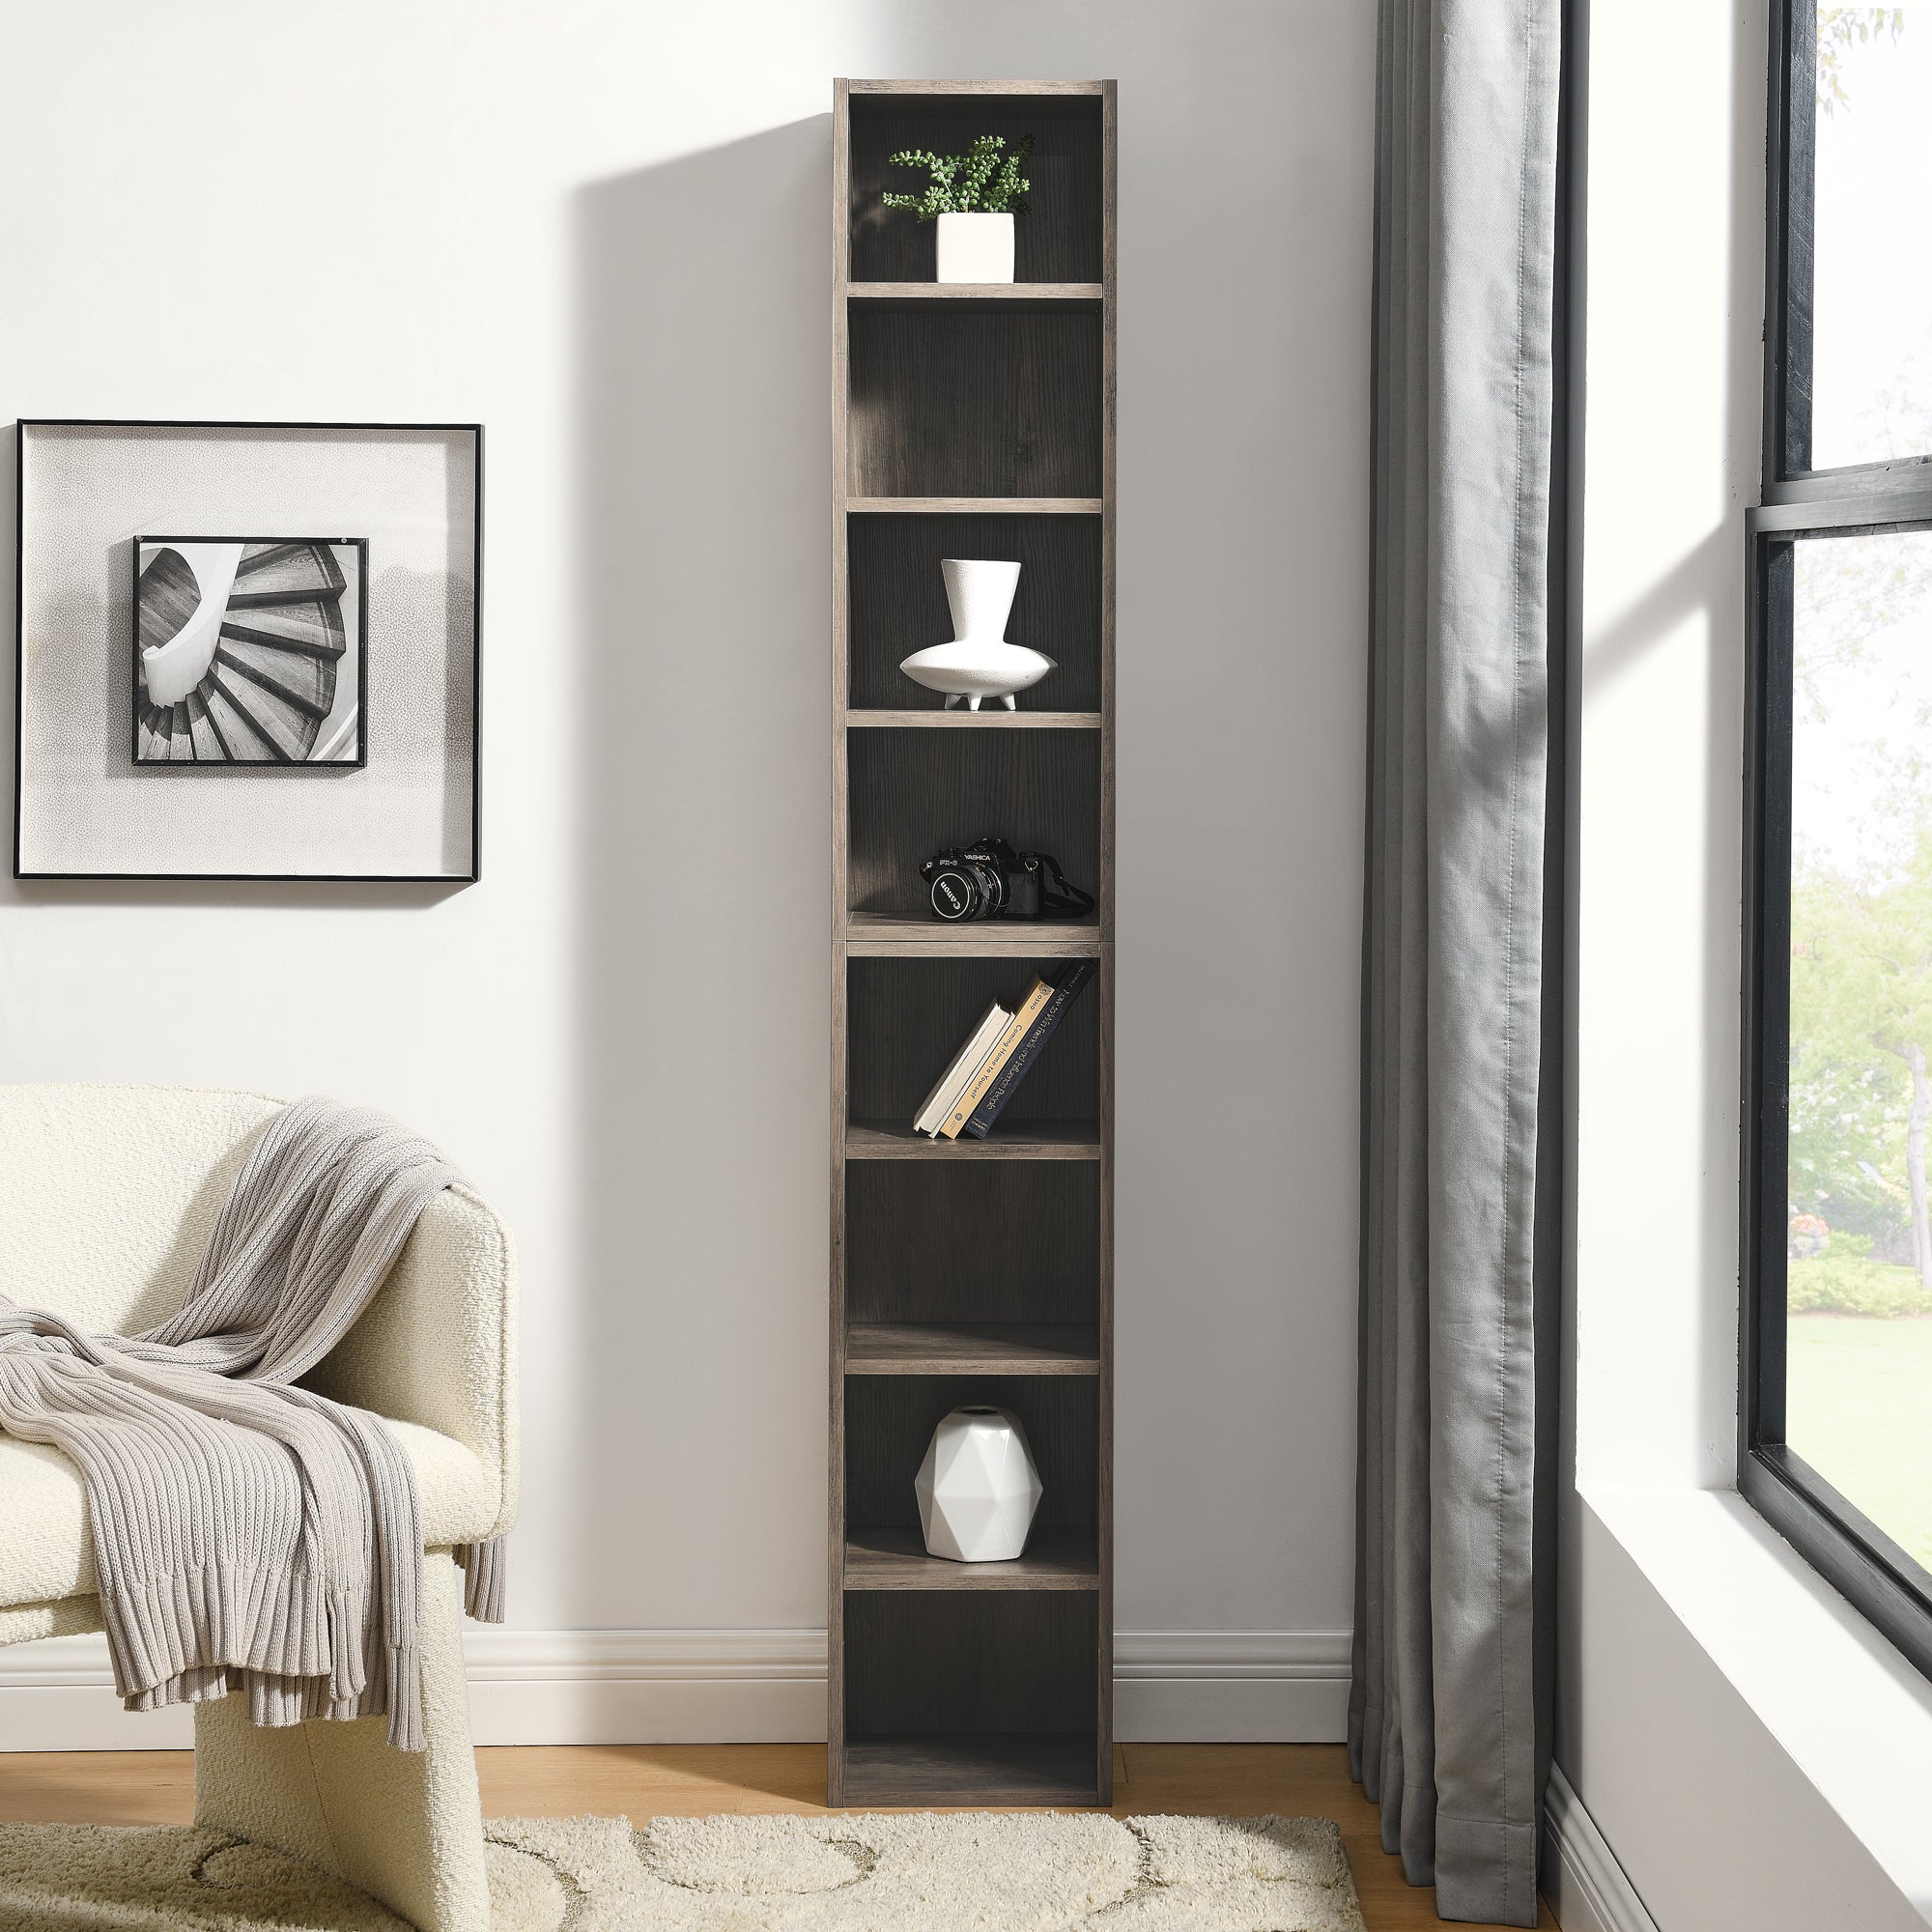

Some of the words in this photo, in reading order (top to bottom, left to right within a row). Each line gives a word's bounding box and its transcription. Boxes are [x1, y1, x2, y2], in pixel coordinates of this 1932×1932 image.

[940, 881, 961, 910] Canon
[1030, 994, 1042, 1010] OSHO
[1004, 1024, 1022, 1047] Coming
[991, 1048, 1007, 1066] Home
[970, 1074, 990, 1099] Yourself
